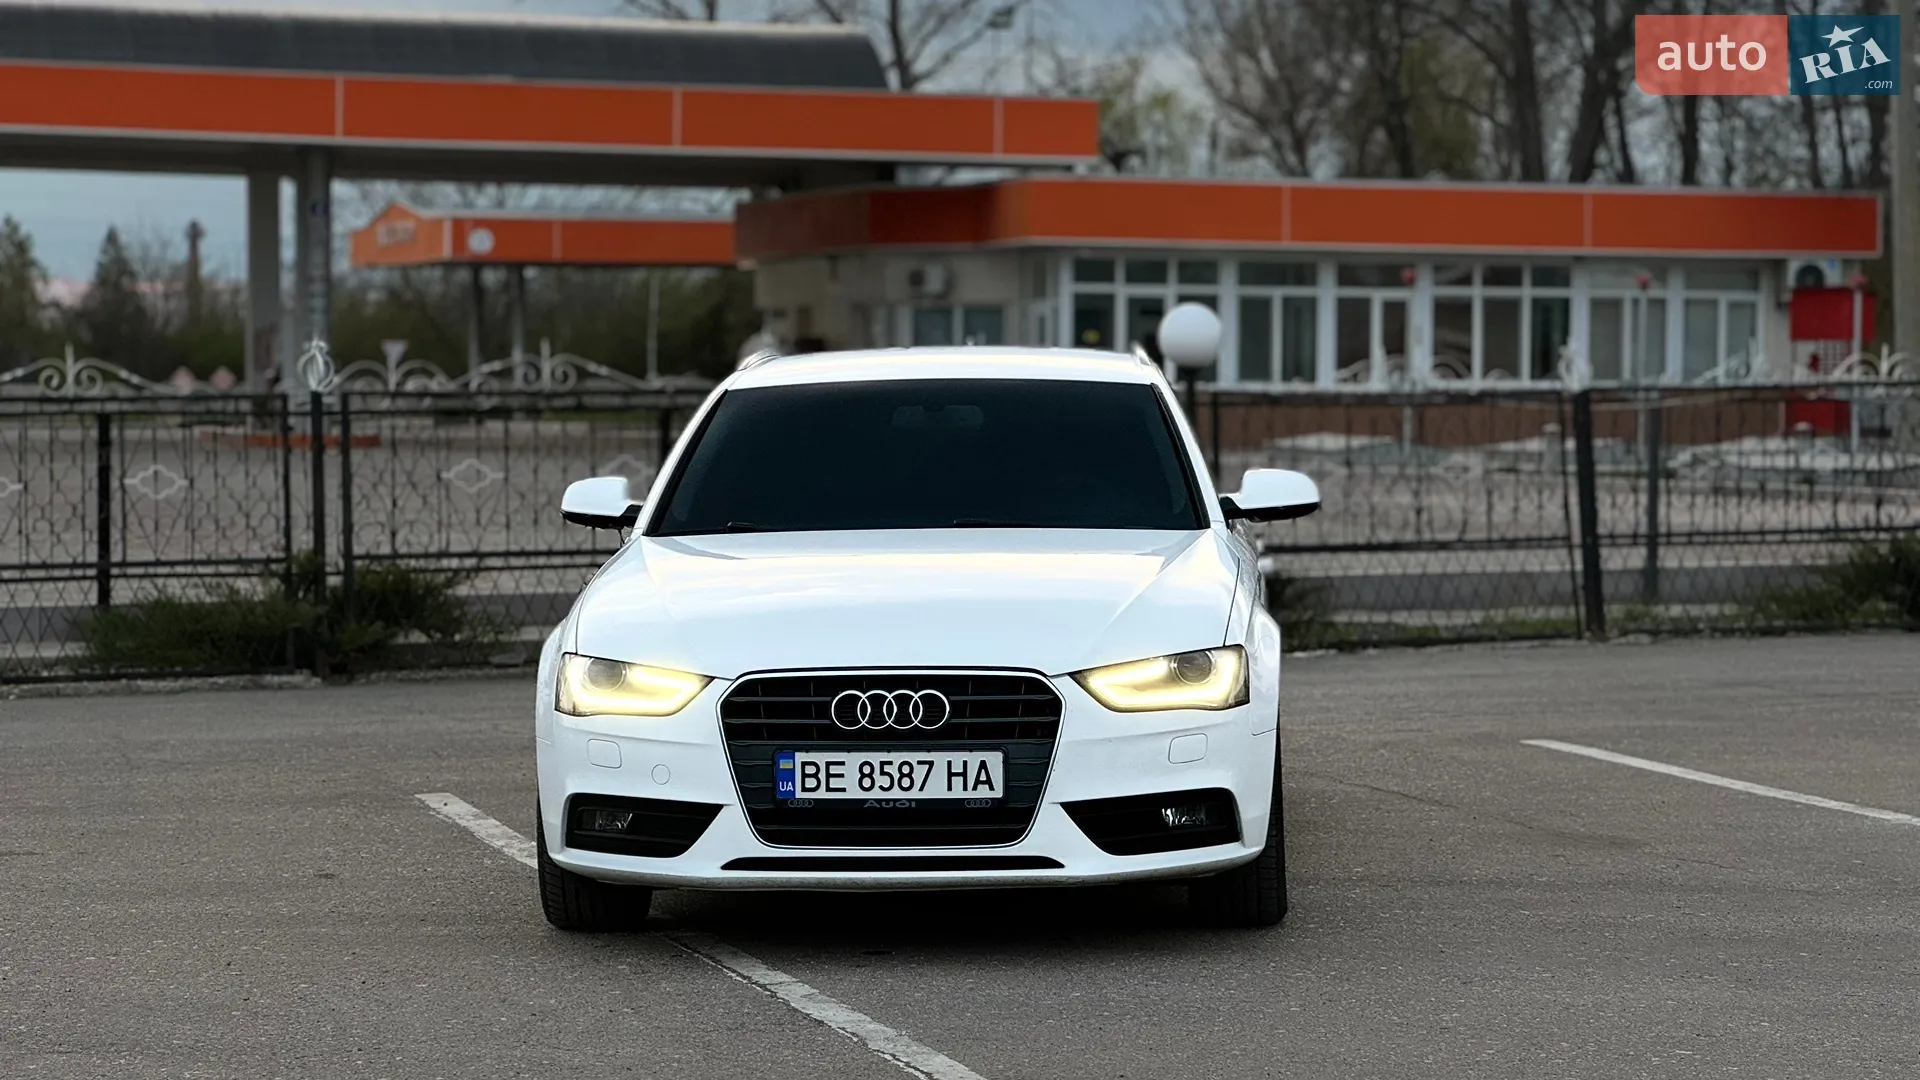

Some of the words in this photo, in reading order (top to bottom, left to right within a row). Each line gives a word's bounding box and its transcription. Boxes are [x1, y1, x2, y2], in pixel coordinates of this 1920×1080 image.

[779, 781, 794, 792] UA
[800, 760, 847, 793] BE
[858, 760, 935, 792] 8587
[946, 759, 996, 792] HA
